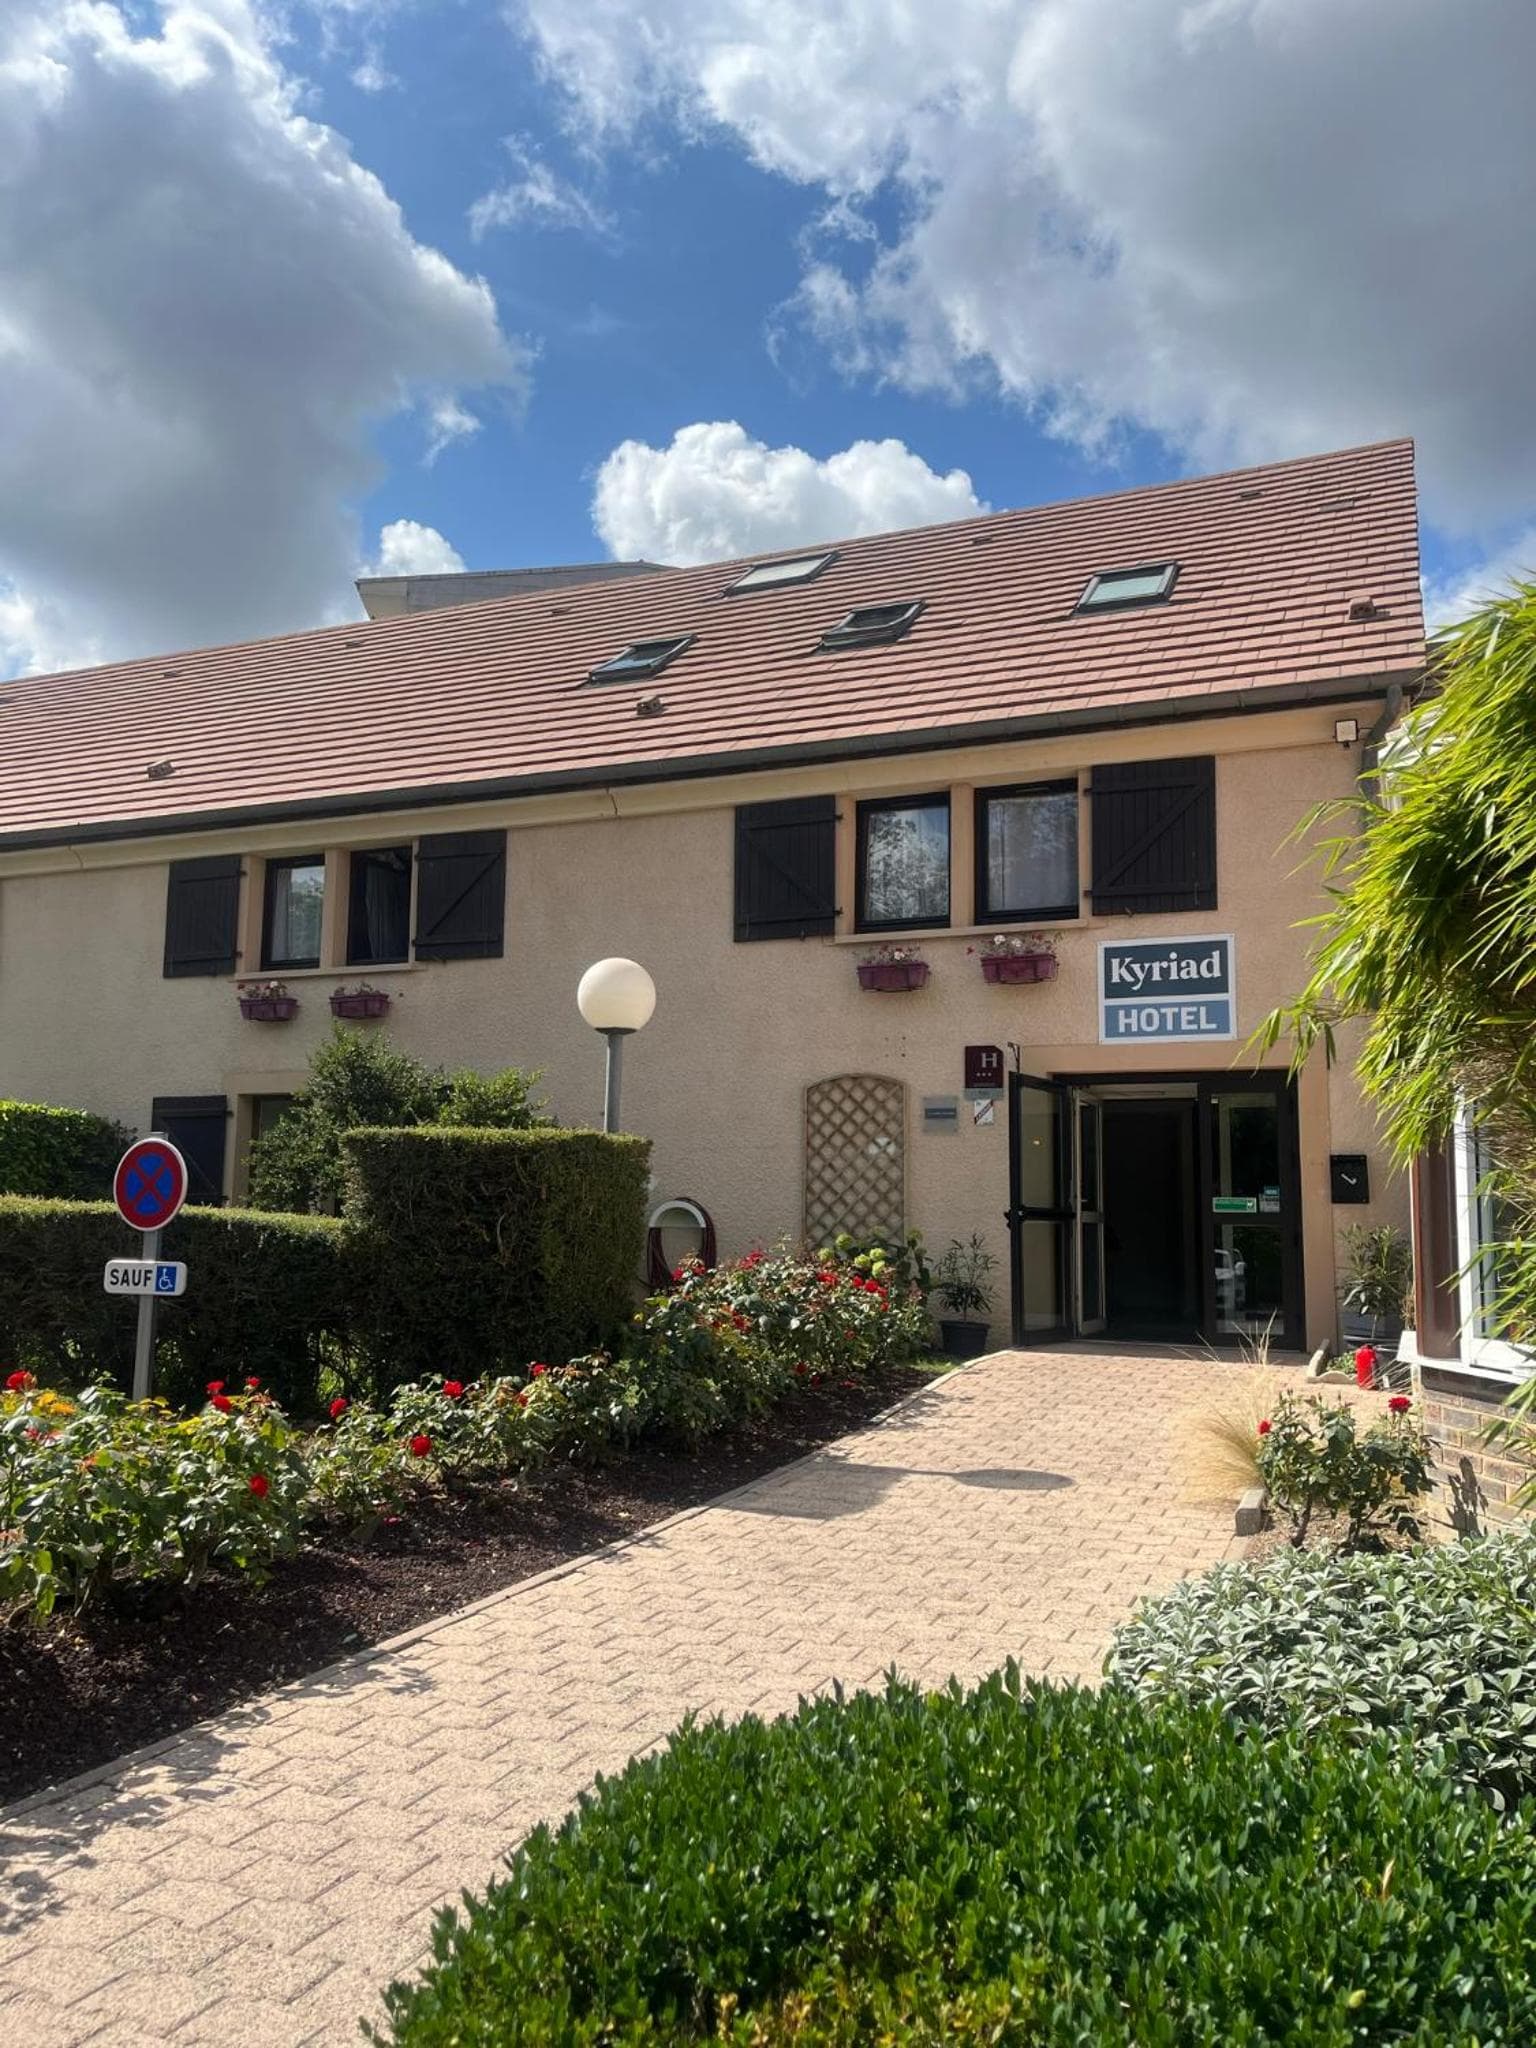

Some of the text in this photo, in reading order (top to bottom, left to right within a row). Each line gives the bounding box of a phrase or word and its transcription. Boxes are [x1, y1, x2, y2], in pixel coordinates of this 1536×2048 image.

[1110, 950, 1221, 990] Kyriad
[1118, 1006, 1217, 1033] HOTEL
[981, 1052, 997, 1068] H
[110, 1268, 153, 1287] SAUF
